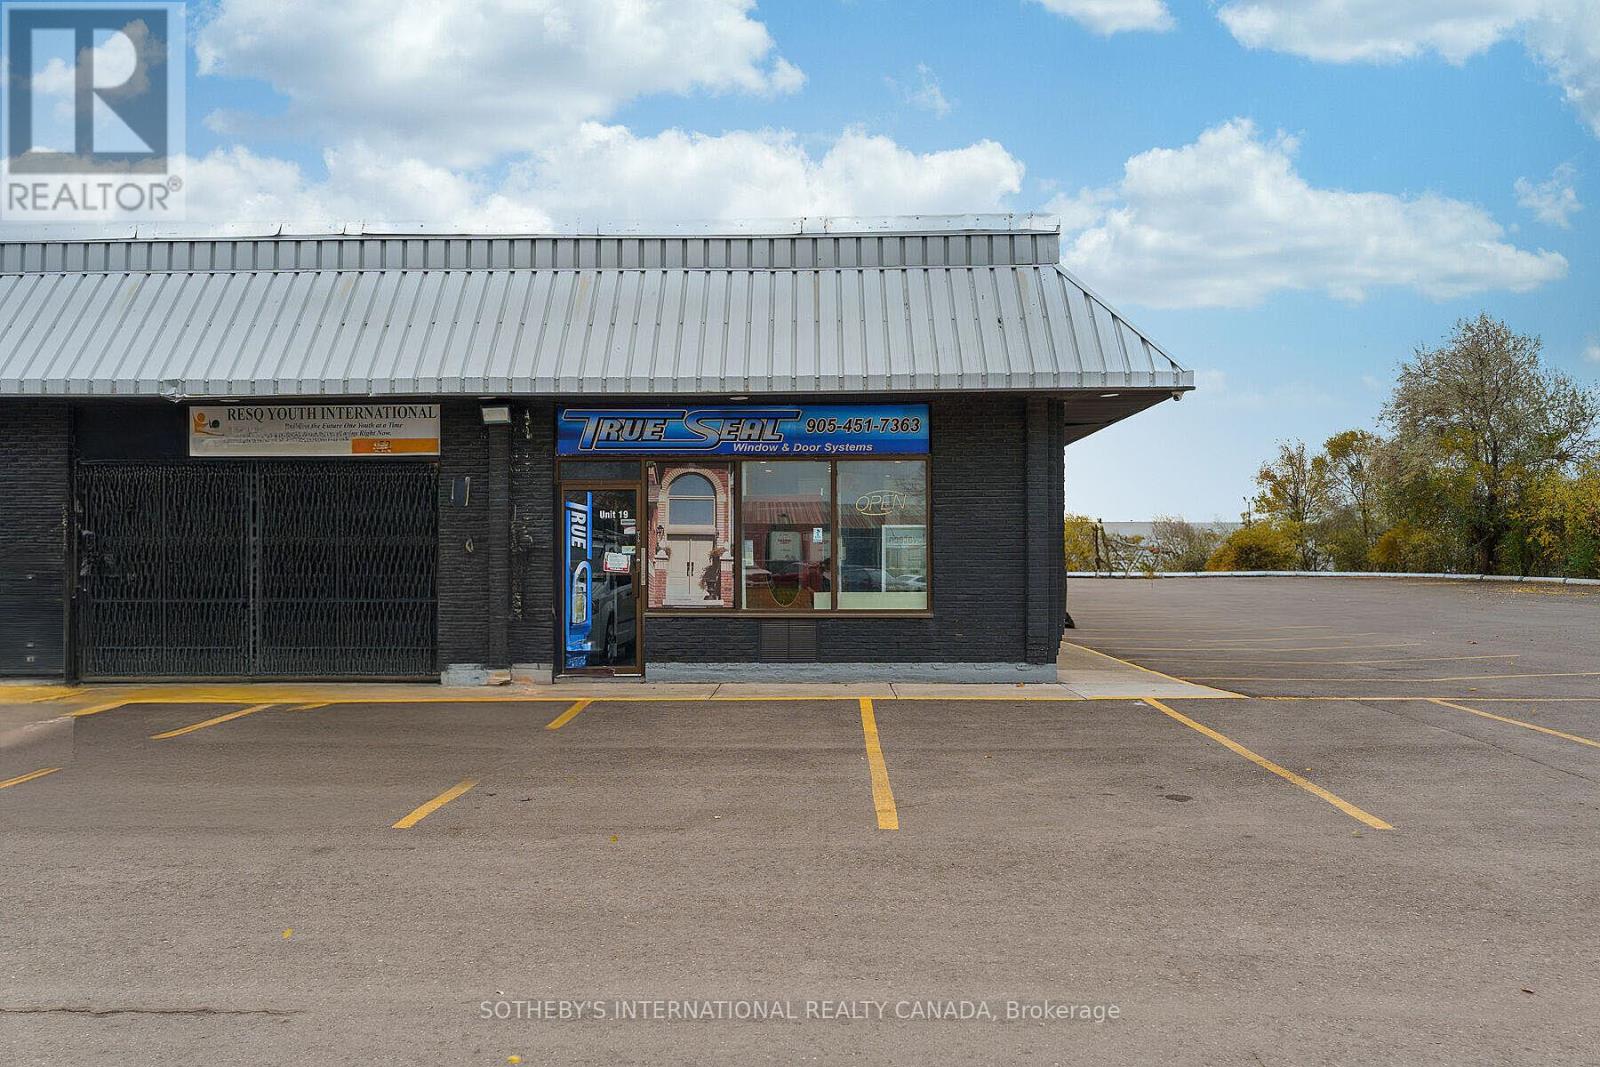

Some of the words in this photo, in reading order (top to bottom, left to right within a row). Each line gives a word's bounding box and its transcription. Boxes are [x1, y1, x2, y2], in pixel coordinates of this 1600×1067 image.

[227, 407, 264, 422] RESQ
[268, 407, 316, 420] YOUTH
[321, 405, 437, 420] INTERNATIONAL
[388, 422, 404, 430] Time
[562, 408, 688, 450] TRUE
[683, 408, 803, 451] SEAL
[805, 417, 921, 434] 905-451-7363
[732, 441, 779, 452] Window
[782, 442, 791, 452] &
[793, 442, 821, 452] Door
[823, 442, 873, 454] Systems
[855, 493, 908, 512] OPEN
[599, 510, 616, 519] Unit
[618, 510, 629, 519] 19
